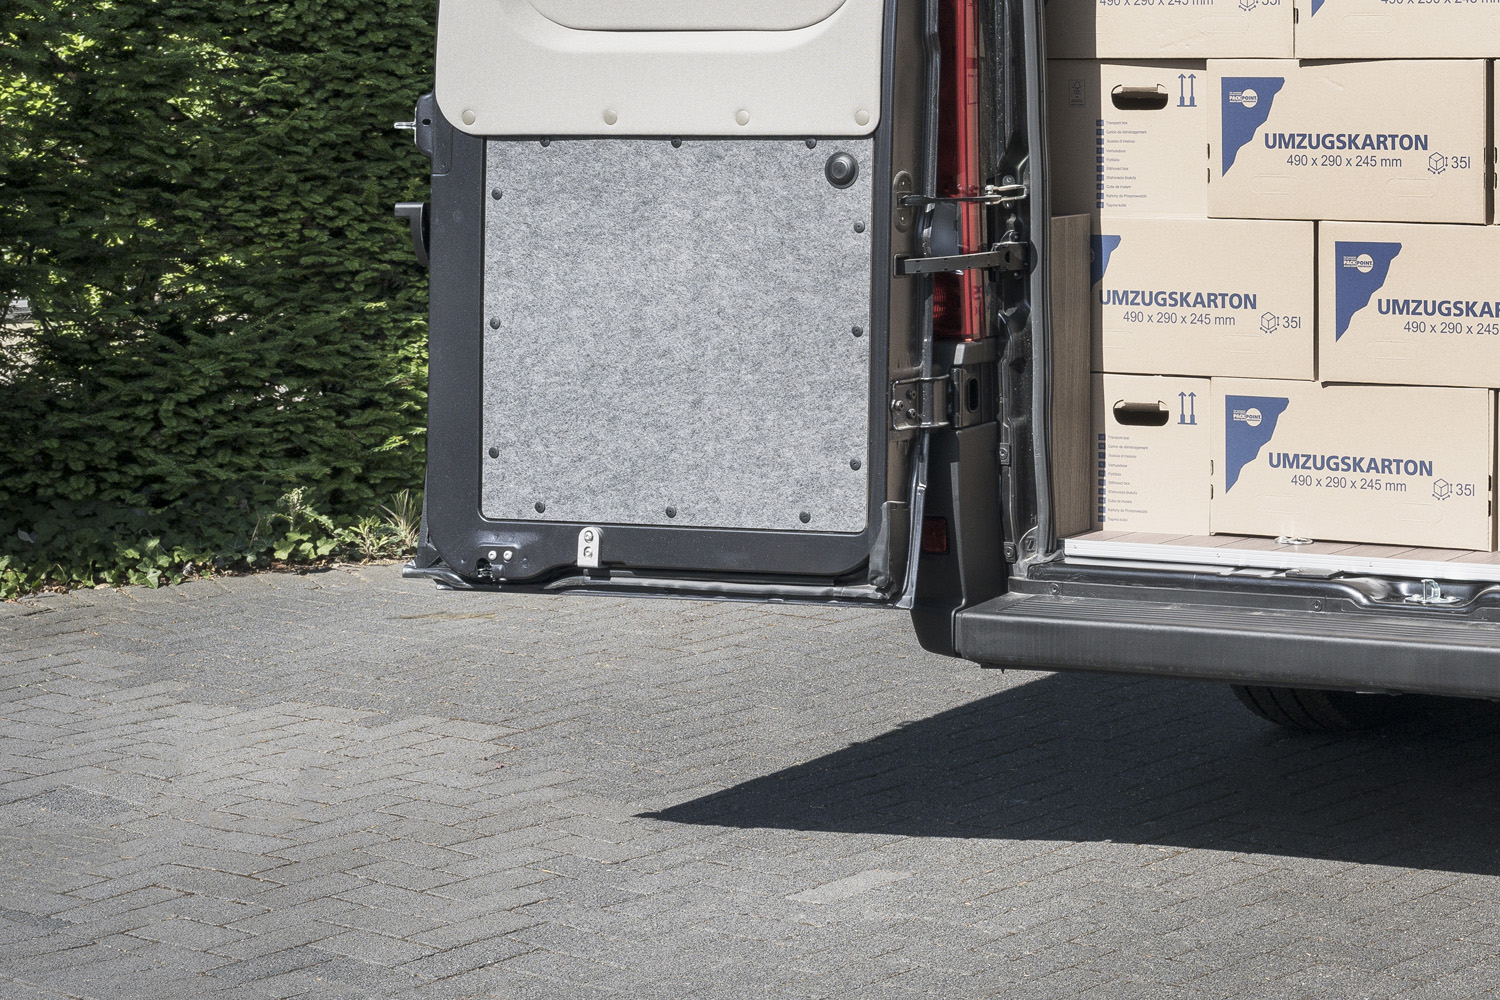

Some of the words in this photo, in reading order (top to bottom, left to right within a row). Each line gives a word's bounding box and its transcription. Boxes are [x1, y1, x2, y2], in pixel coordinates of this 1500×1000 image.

[1265, 133, 1428, 151] UMZUGSKARTON
[1287, 154, 1308, 166] 490
[1312, 158, 1317, 166] x
[1321, 155, 1342, 166] 290
[1346, 158, 1352, 166] x
[1356, 155, 1377, 166] 245
[1381, 158, 1401, 167] mm
[1099, 289, 1256, 309] UMZUGSKARTON
[1123, 310, 1143, 322] 490
[1157, 311, 1177, 324] 290
[1191, 313, 1211, 325] 245
[1215, 316, 1235, 326] mm
[1404, 320, 1426, 333] 490
[1430, 324, 1436, 333] x
[1441, 321, 1462, 334] 290
[1466, 326, 1473, 334] x
[1477, 323, 1499, 335] 245
[1269, 452, 1432, 476] UMZUGSKARTON
[1291, 474, 1312, 486] 490
[1316, 478, 1322, 486] x
[1326, 476, 1346, 488] 290
[1350, 480, 1356, 488] x
[1360, 478, 1381, 491] 245
[1386, 482, 1406, 492] mm
